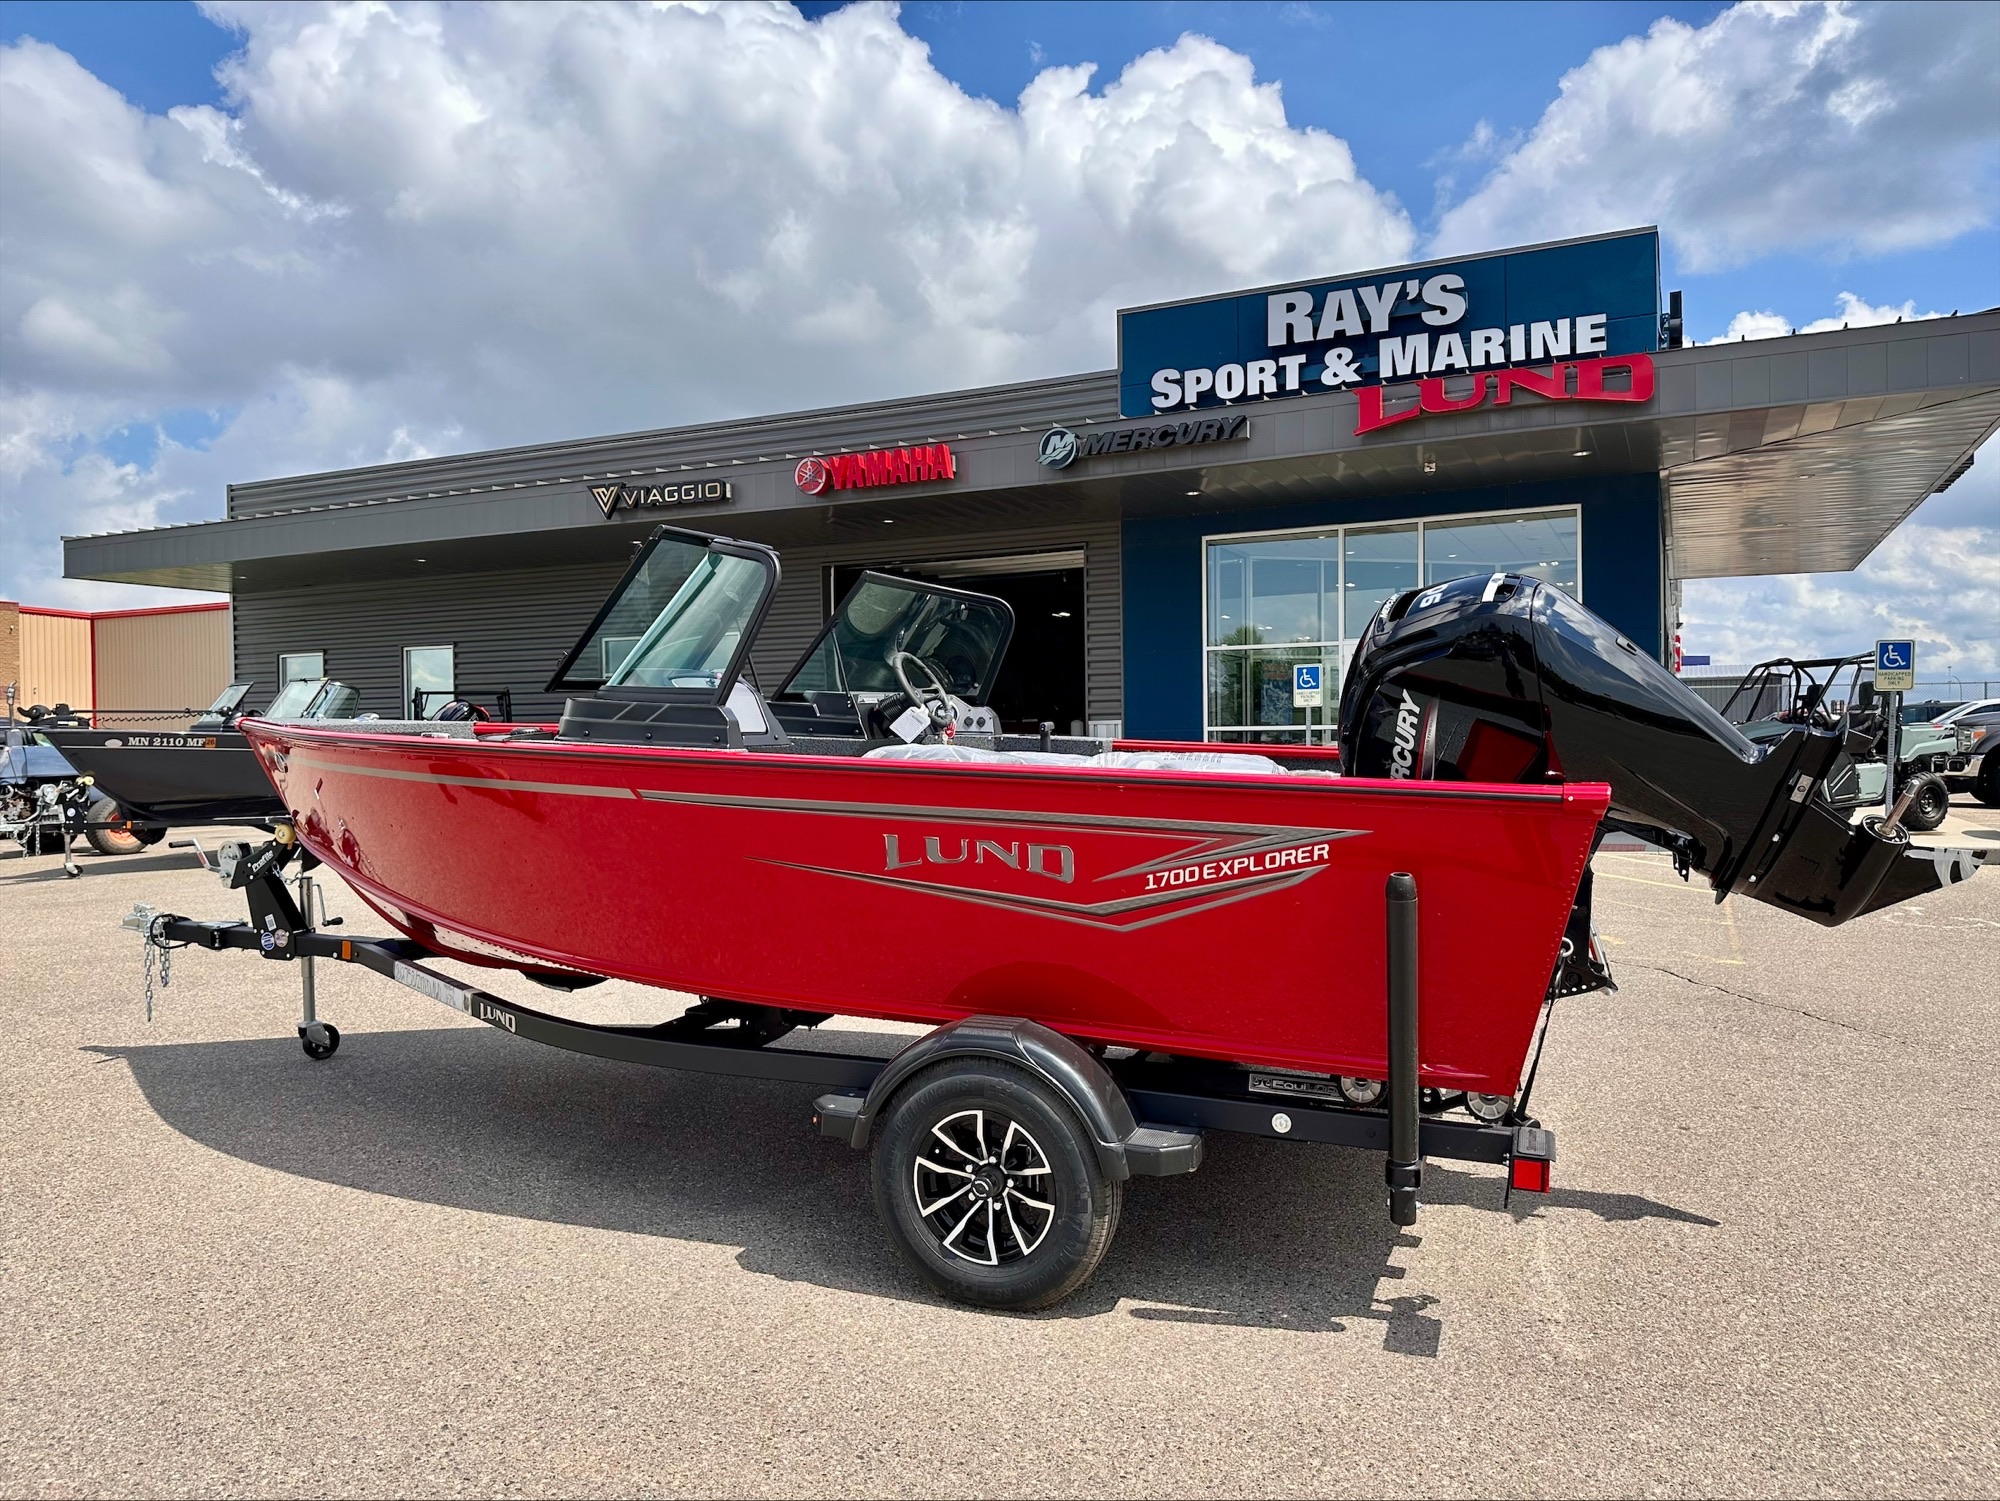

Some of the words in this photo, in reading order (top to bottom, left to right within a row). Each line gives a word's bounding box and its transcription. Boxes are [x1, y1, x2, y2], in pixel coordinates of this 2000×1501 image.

[1267, 273, 1466, 347] RAY'S
[1150, 354, 1306, 409] SPORT
[1320, 346, 1363, 387] &
[1378, 313, 1608, 377] MARINE
[1353, 353, 1655, 437] LUND
[1084, 415, 1248, 455] MERCURY
[829, 443, 954, 490] YAMAHA
[621, 480, 724, 507] VIAGGIO
[128, 737, 150, 746] MN
[153, 737, 184, 746] 2110
[186, 738, 205, 746] MF
[1390, 688, 1421, 780] RCURY
[882, 833, 1075, 885] LUND
[1144, 865, 1199, 891] 1700
[1203, 843, 1331, 880] EXPLORER
[479, 1002, 517, 1034] LUND
